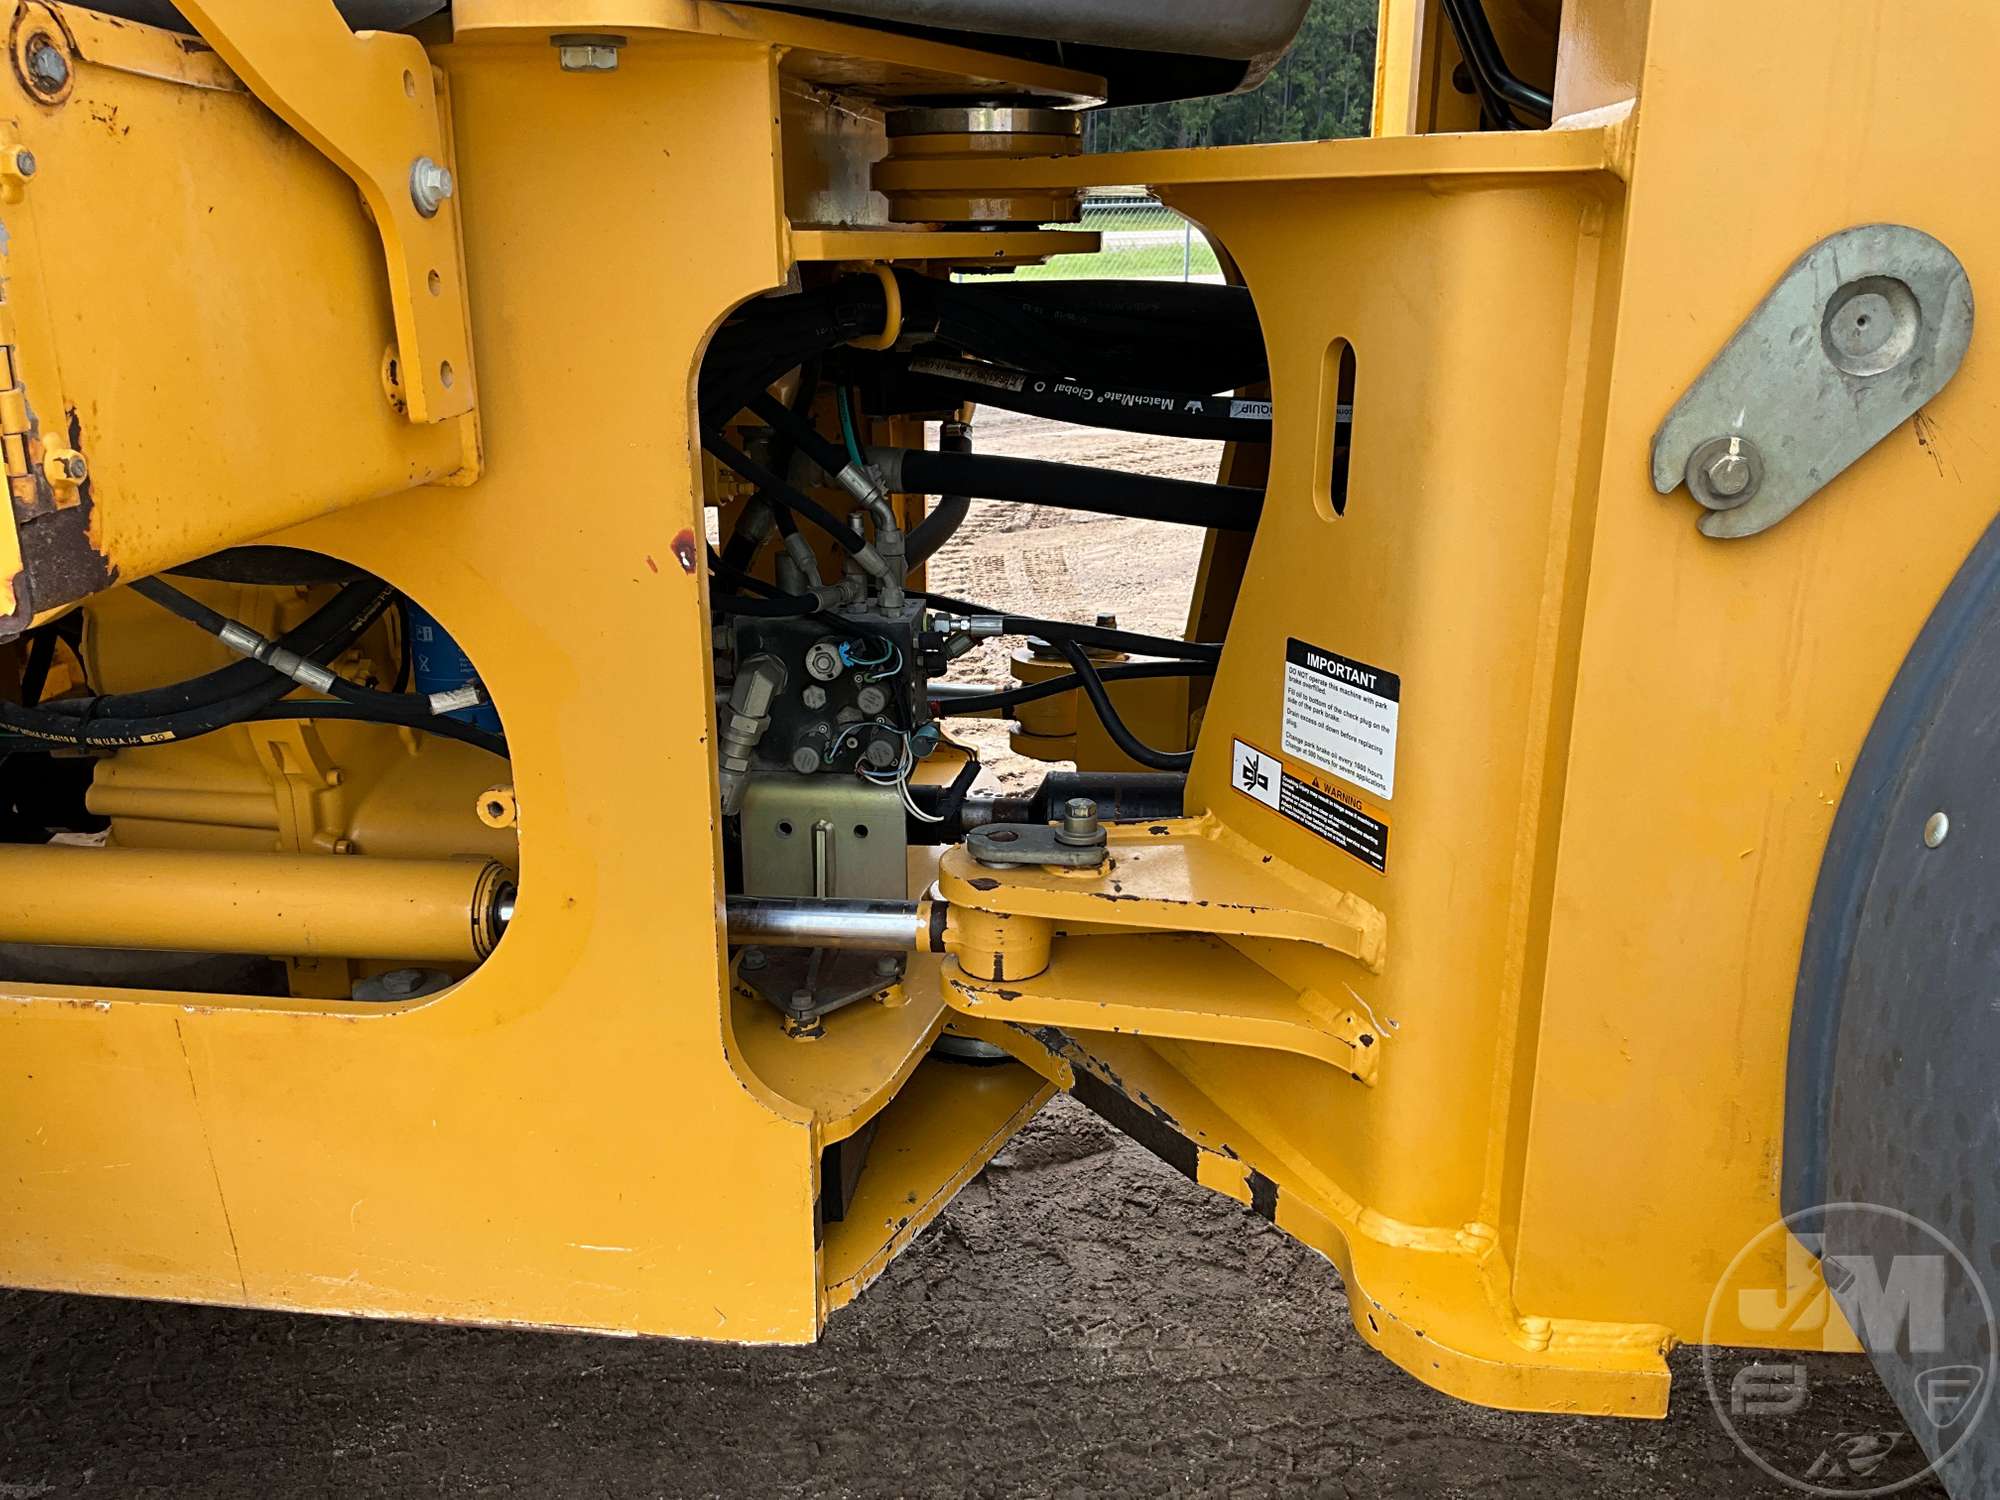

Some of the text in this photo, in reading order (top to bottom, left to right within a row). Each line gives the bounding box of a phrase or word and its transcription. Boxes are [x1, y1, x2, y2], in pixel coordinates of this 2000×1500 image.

[1054, 383, 1094, 401] Global
[1288, 674, 1326, 695] brake overfilled.
[1288, 666, 1387, 712] DO NOT operate this machine with park
[1306, 651, 1376, 690] IMPORTANT
[1287, 695, 1297, 705] side
[1297, 700, 1303, 708] of
[1303, 702, 1312, 711] the
[1312, 706, 1323, 717] park
[1287, 686, 1295, 696] Fill
[1302, 693, 1307, 701] to
[1308, 695, 1326, 708] bottom
[1327, 702, 1332, 711] of
[1333, 705, 1342, 715] the
[1343, 709, 1358, 721] check
[1359, 716, 1371, 728] plug
[1373, 722, 1380, 730] on
[1381, 724, 1389, 734] the
[1285, 730, 1303, 745] Change
[1304, 739, 1314, 750] park
[1316, 744, 1330, 756] brake
[1338, 755, 1352, 767] every
[1286, 707, 1299, 718] Drain
[1300, 714, 1316, 726] excess
[1325, 723, 1339, 735] down
[1340, 729, 1357, 743] before
[1358, 737, 1383, 755] replacing
[1285, 739, 1301, 753] Change
[1307, 749, 1316, 759] 500
[1316, 753, 1330, 765] hours
[1339, 764, 1354, 776] severe
[1323, 783, 1362, 810] WARNING
